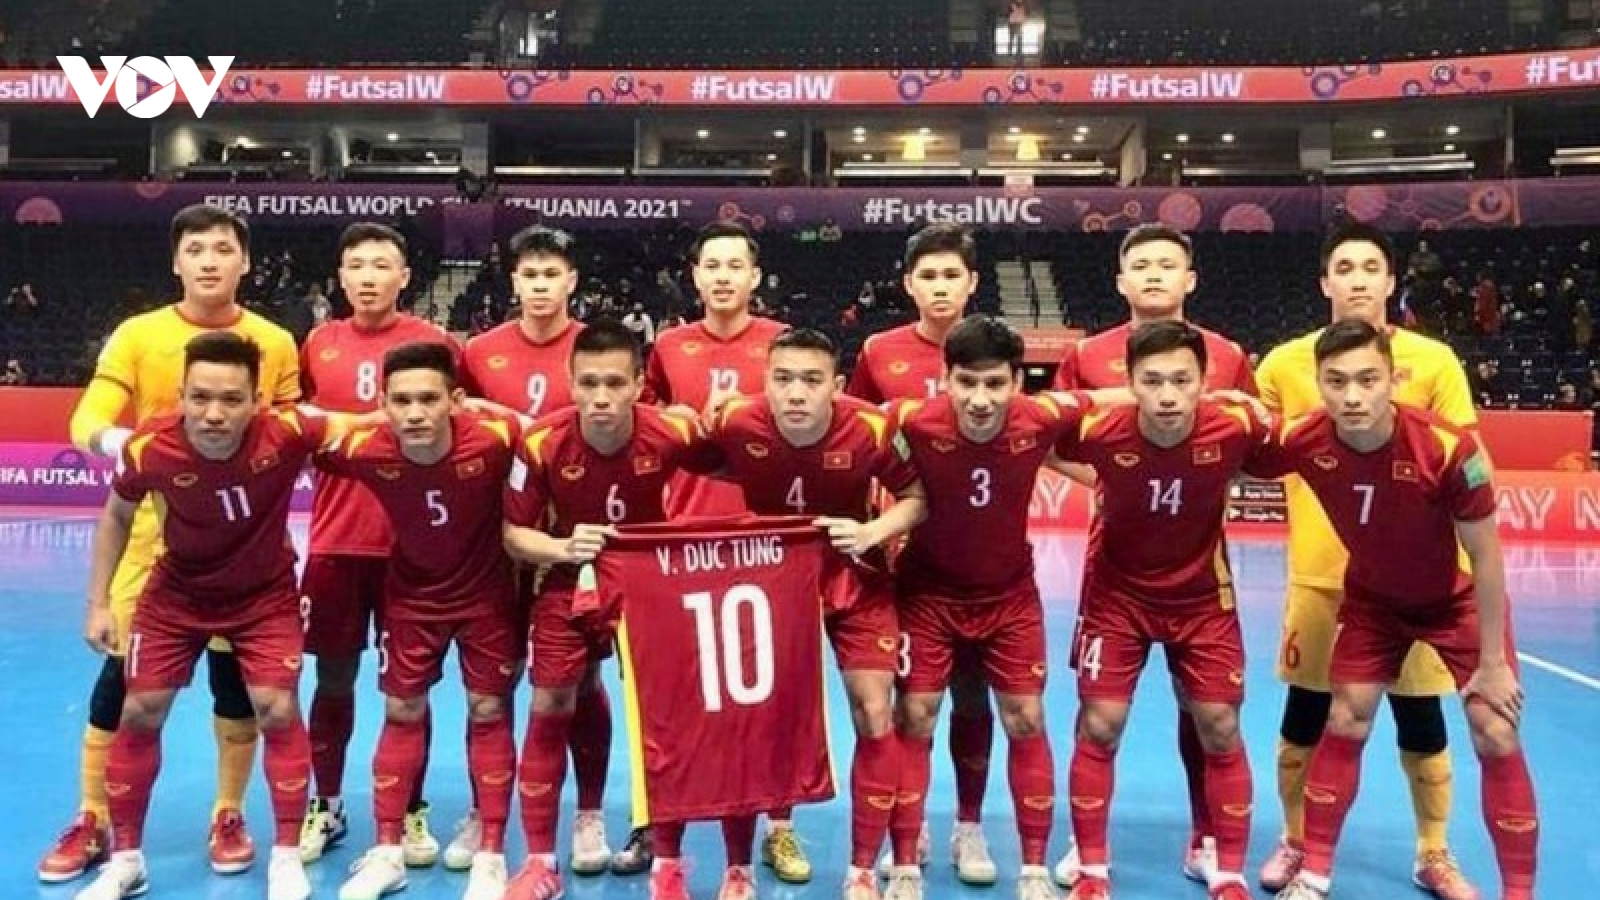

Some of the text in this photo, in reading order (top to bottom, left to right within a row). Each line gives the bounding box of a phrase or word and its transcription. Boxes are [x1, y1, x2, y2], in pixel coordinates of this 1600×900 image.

[306, 71, 445, 100] #FutsalW
[691, 74, 835, 101] #FutsalW
[1091, 70, 1244, 99] #FutsalW
[257, 195, 344, 215] FUTSAL
[863, 195, 1042, 224] #FutsalWC
[356, 361, 375, 401] 8
[527, 373, 547, 414] 9
[32, 467, 99, 487] FUTSAL
[785, 476, 806, 514] 4
[969, 467, 992, 507] 3
[216, 485, 251, 521] 11
[426, 489, 449, 526] 5
[606, 483, 627, 522] 6
[1148, 478, 1183, 516] 14
[1353, 485, 1375, 525] 7
[683, 540, 726, 572] DUC
[730, 535, 784, 568] TUNG
[682, 583, 775, 713] 10
